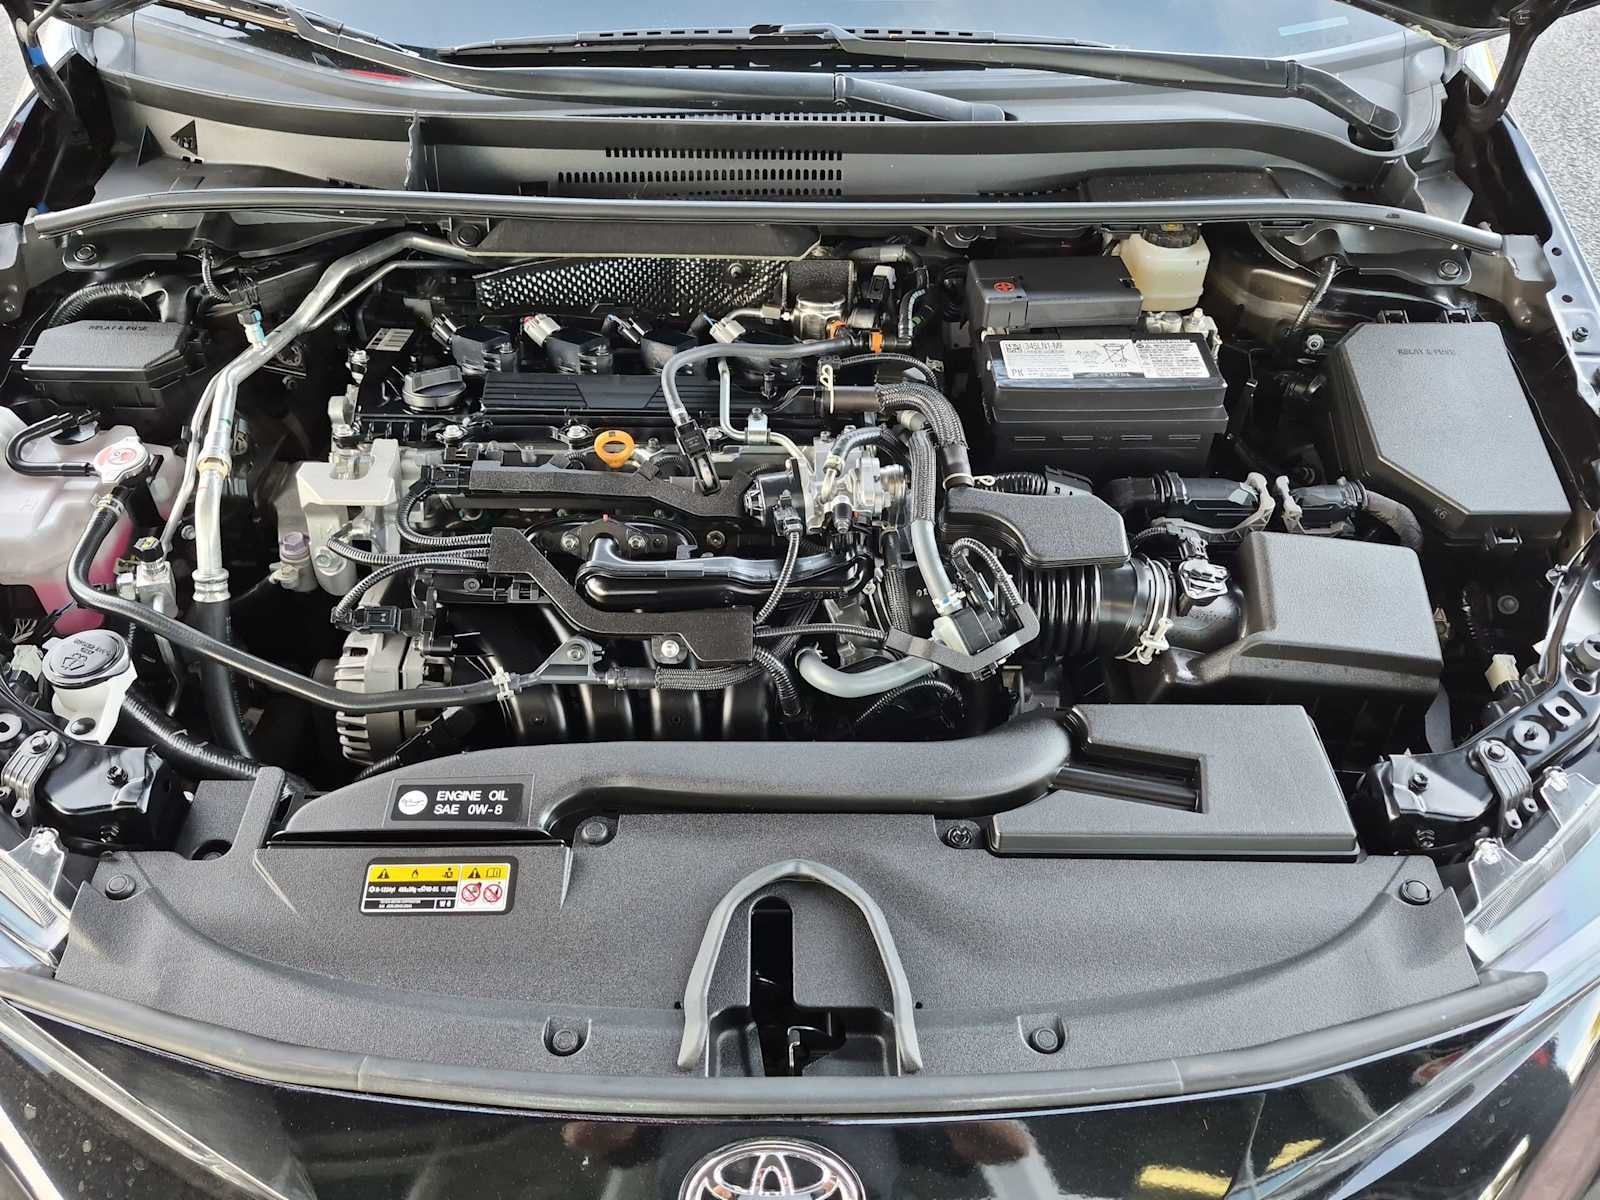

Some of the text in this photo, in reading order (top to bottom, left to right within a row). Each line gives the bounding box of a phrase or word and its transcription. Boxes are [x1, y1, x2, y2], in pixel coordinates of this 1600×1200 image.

[436, 790, 509, 801] ENGINE OIL
[433, 804, 503, 815] SAE 0W-8
